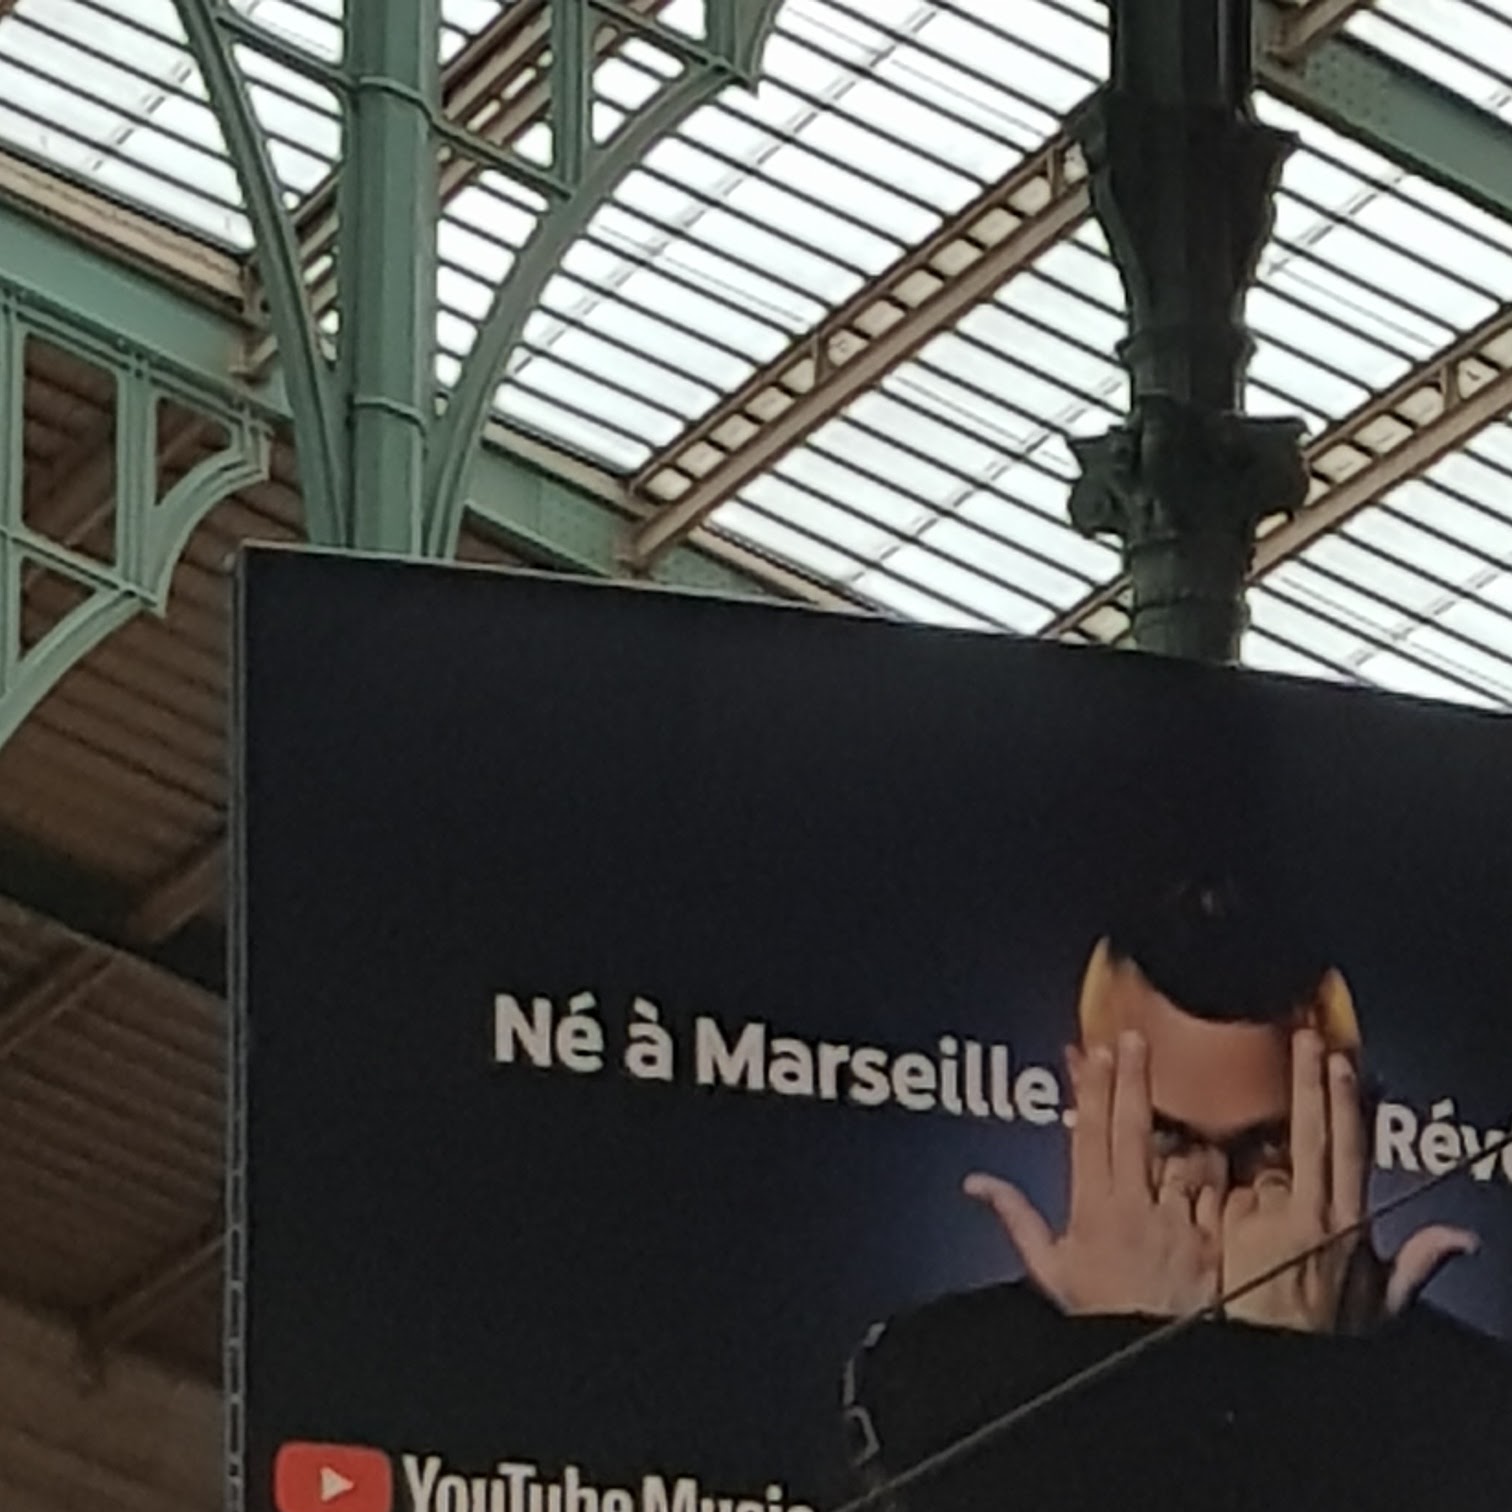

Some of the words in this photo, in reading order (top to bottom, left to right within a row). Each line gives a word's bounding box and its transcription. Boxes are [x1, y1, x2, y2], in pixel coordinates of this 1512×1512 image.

[493, 990, 605, 1072] Né
[624, 997, 675, 1082] à
[694, 1016, 1078, 1129] Marseille.
